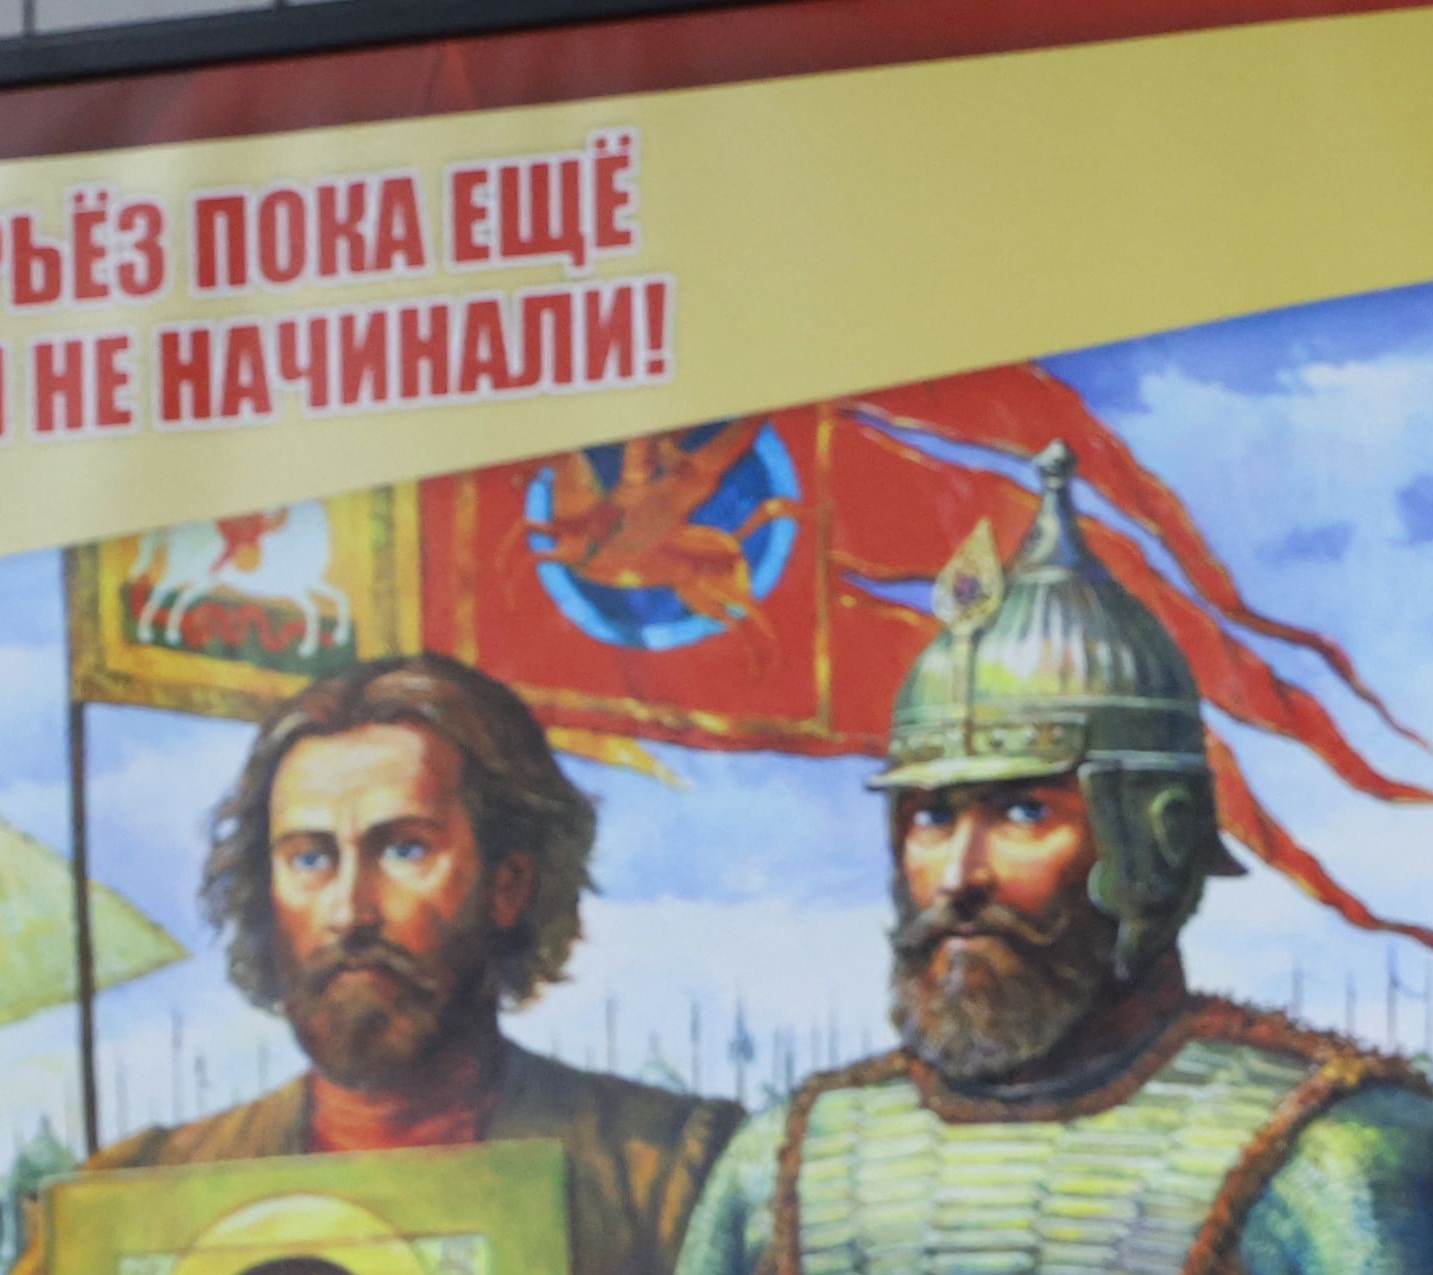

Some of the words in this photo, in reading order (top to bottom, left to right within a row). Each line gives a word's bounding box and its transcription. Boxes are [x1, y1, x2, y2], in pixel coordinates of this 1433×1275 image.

[195, 176, 426, 290] ПОКА
[452, 134, 633, 267] ЕЩЁ
[34, 335, 132, 433] НЕ
[160, 281, 666, 423] НАЧИНАЛИ!
